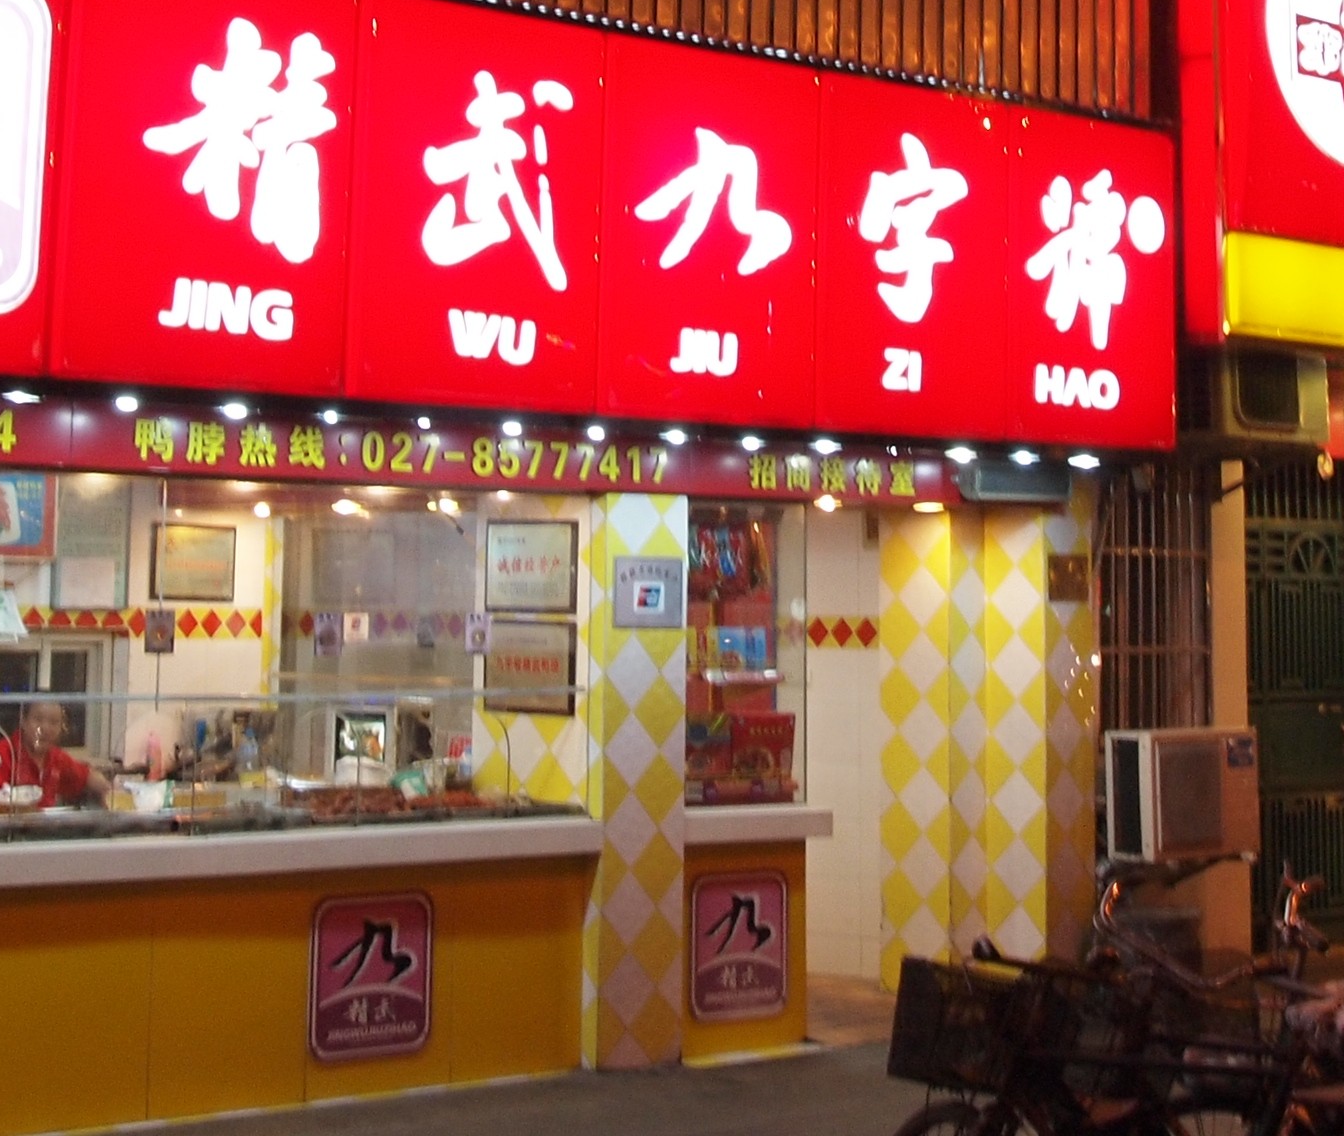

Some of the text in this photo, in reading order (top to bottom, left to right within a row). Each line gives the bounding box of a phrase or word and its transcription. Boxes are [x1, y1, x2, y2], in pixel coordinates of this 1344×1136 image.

[157, 277, 1120, 410] JING WU JIU ZI HAO
